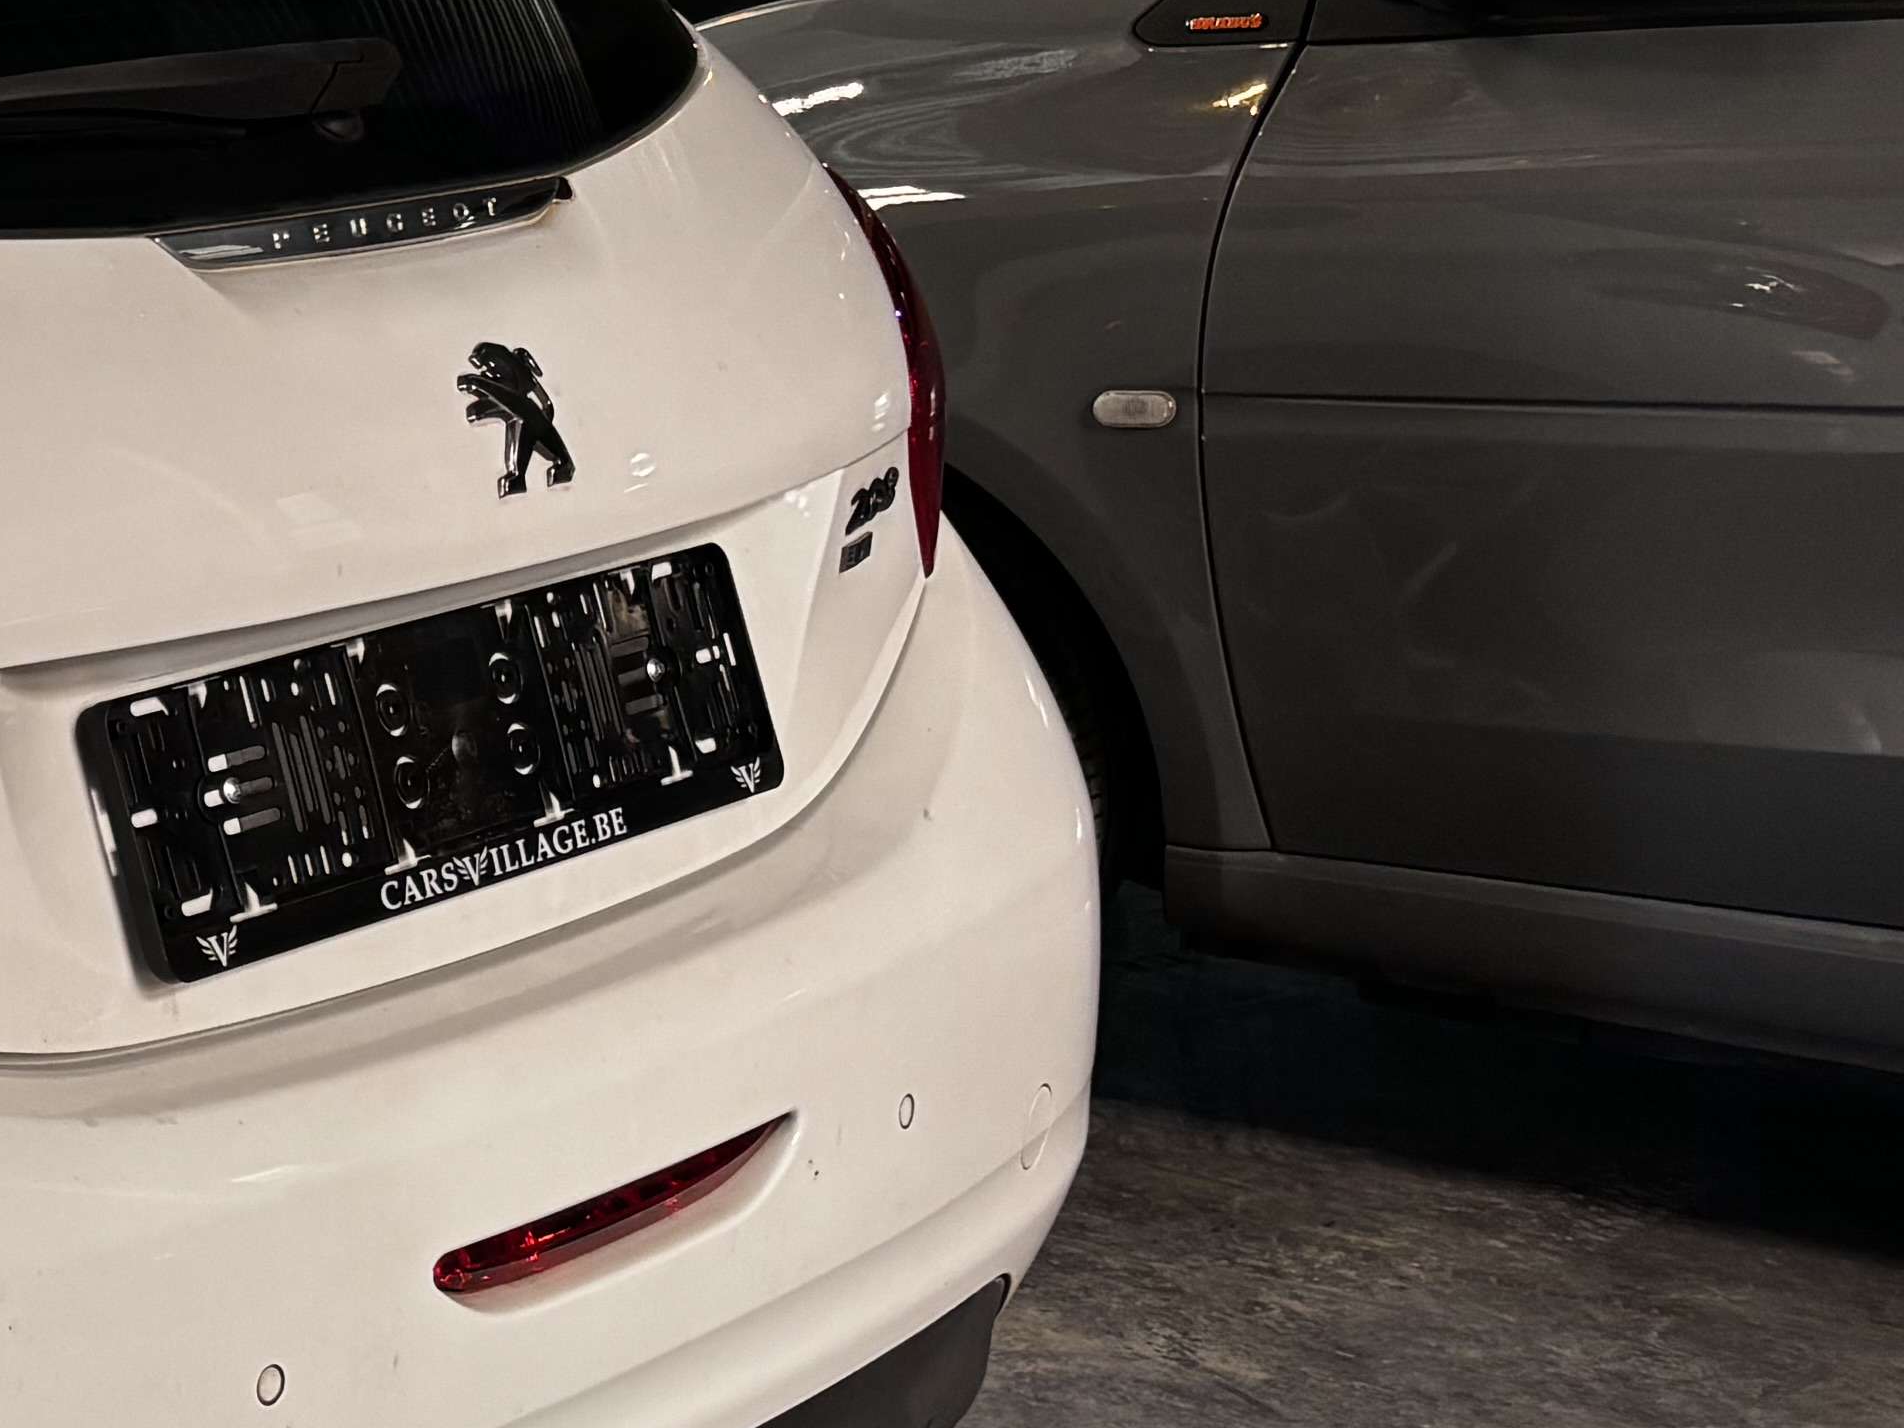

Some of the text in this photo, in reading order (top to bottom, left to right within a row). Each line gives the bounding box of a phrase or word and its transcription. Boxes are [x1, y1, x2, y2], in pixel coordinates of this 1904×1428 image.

[272, 197, 497, 250] PEUGEOT
[844, 466, 900, 536] 208
[380, 806, 629, 911] CARSVILLAGE.BE
